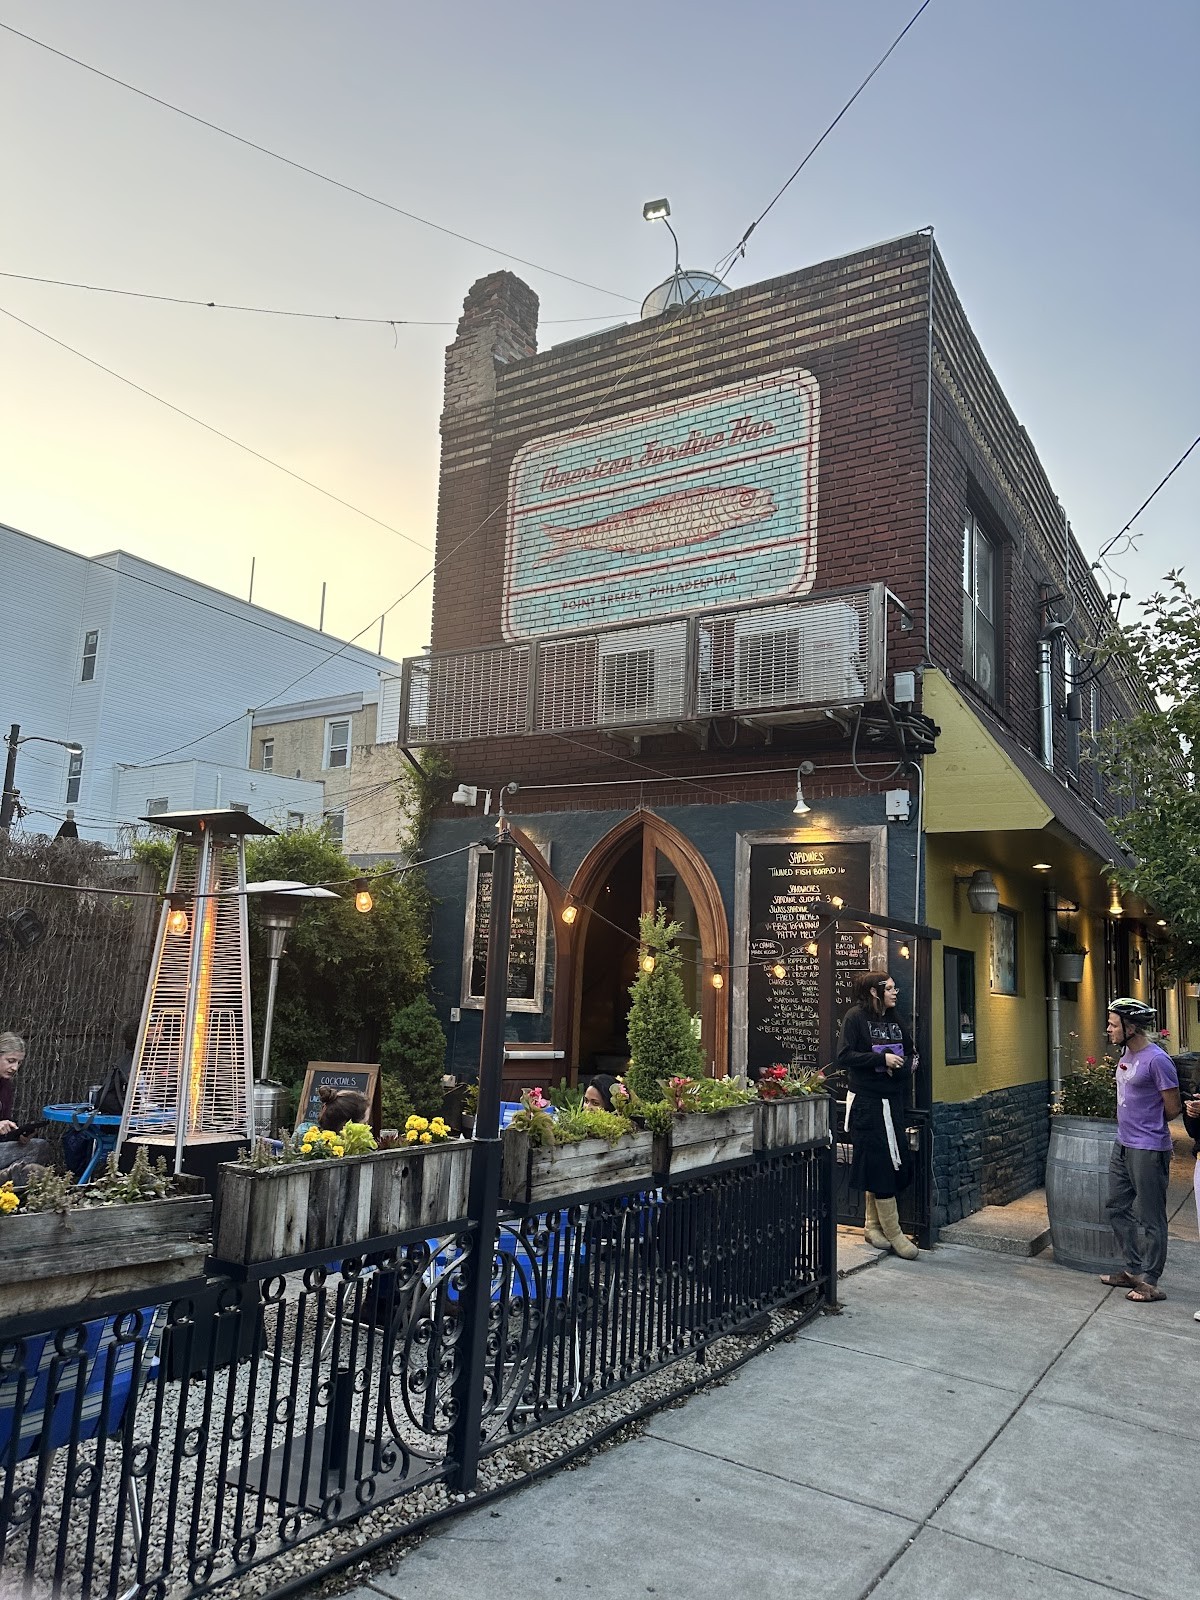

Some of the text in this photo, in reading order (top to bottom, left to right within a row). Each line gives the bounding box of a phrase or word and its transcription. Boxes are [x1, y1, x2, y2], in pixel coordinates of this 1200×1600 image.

[540, 416, 776, 491] American Sardine Bar
[562, 571, 737, 612] POINT BREEZE PHILADELPHIA
[788, 851, 824, 864] SARDINES
[768, 867, 793, 877] TINNED
[795, 868, 811, 876] FISH
[813, 867, 836, 875] BOARD
[787, 885, 821, 894] SANDWICHES
[772, 895, 797, 904] SARDINE
[776, 931, 816, 939] PATTY MELT
[793, 1004, 813, 1012] SALAD
[321, 1076, 356, 1086] COCKTAILS
